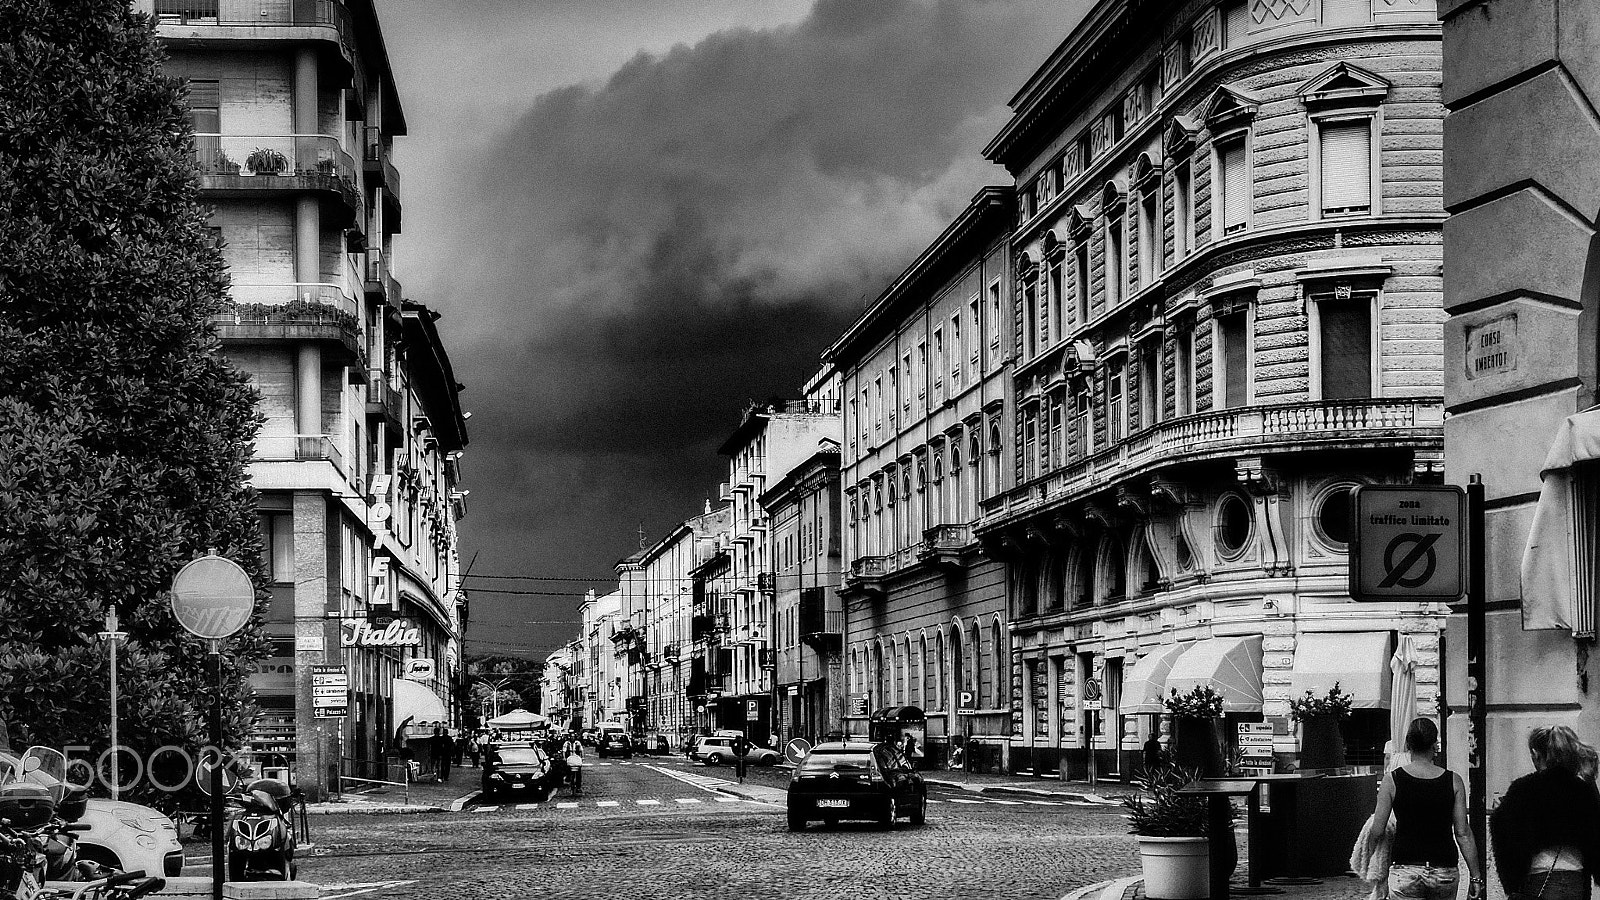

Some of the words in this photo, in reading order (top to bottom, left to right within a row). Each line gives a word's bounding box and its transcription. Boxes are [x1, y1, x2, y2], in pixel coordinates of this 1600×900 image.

[1481, 330, 1501, 348] CORSO
[1399, 500, 1420, 509] zona
[1370, 514, 1407, 525] traffico
[1411, 514, 1450, 526] limitato
[369, 474, 392, 605] HOTEL
[341, 619, 420, 646] Italia
[748, 701, 756, 711] P
[960, 692, 972, 707] P
